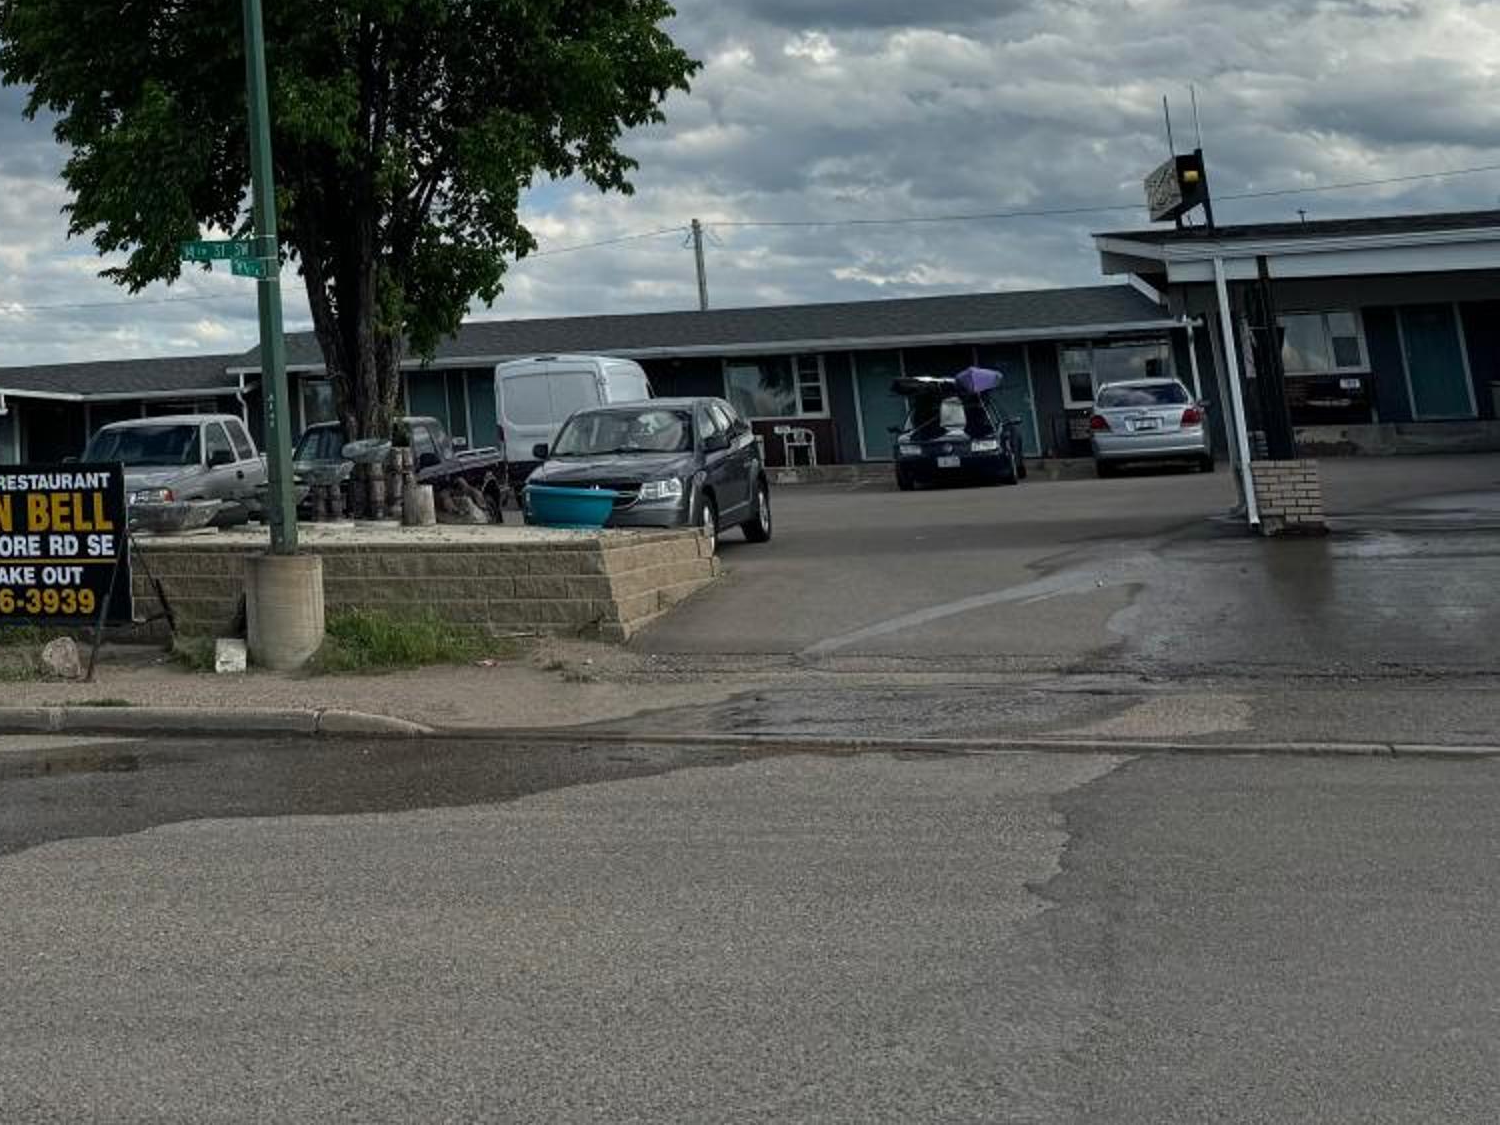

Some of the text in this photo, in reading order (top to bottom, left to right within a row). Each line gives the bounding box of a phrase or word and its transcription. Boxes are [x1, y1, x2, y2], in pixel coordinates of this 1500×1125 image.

[27, 491, 113, 532] BELL
[49, 535, 79, 556] RD
[87, 535, 115, 556] SE
[42, 567, 84, 584] OUT
